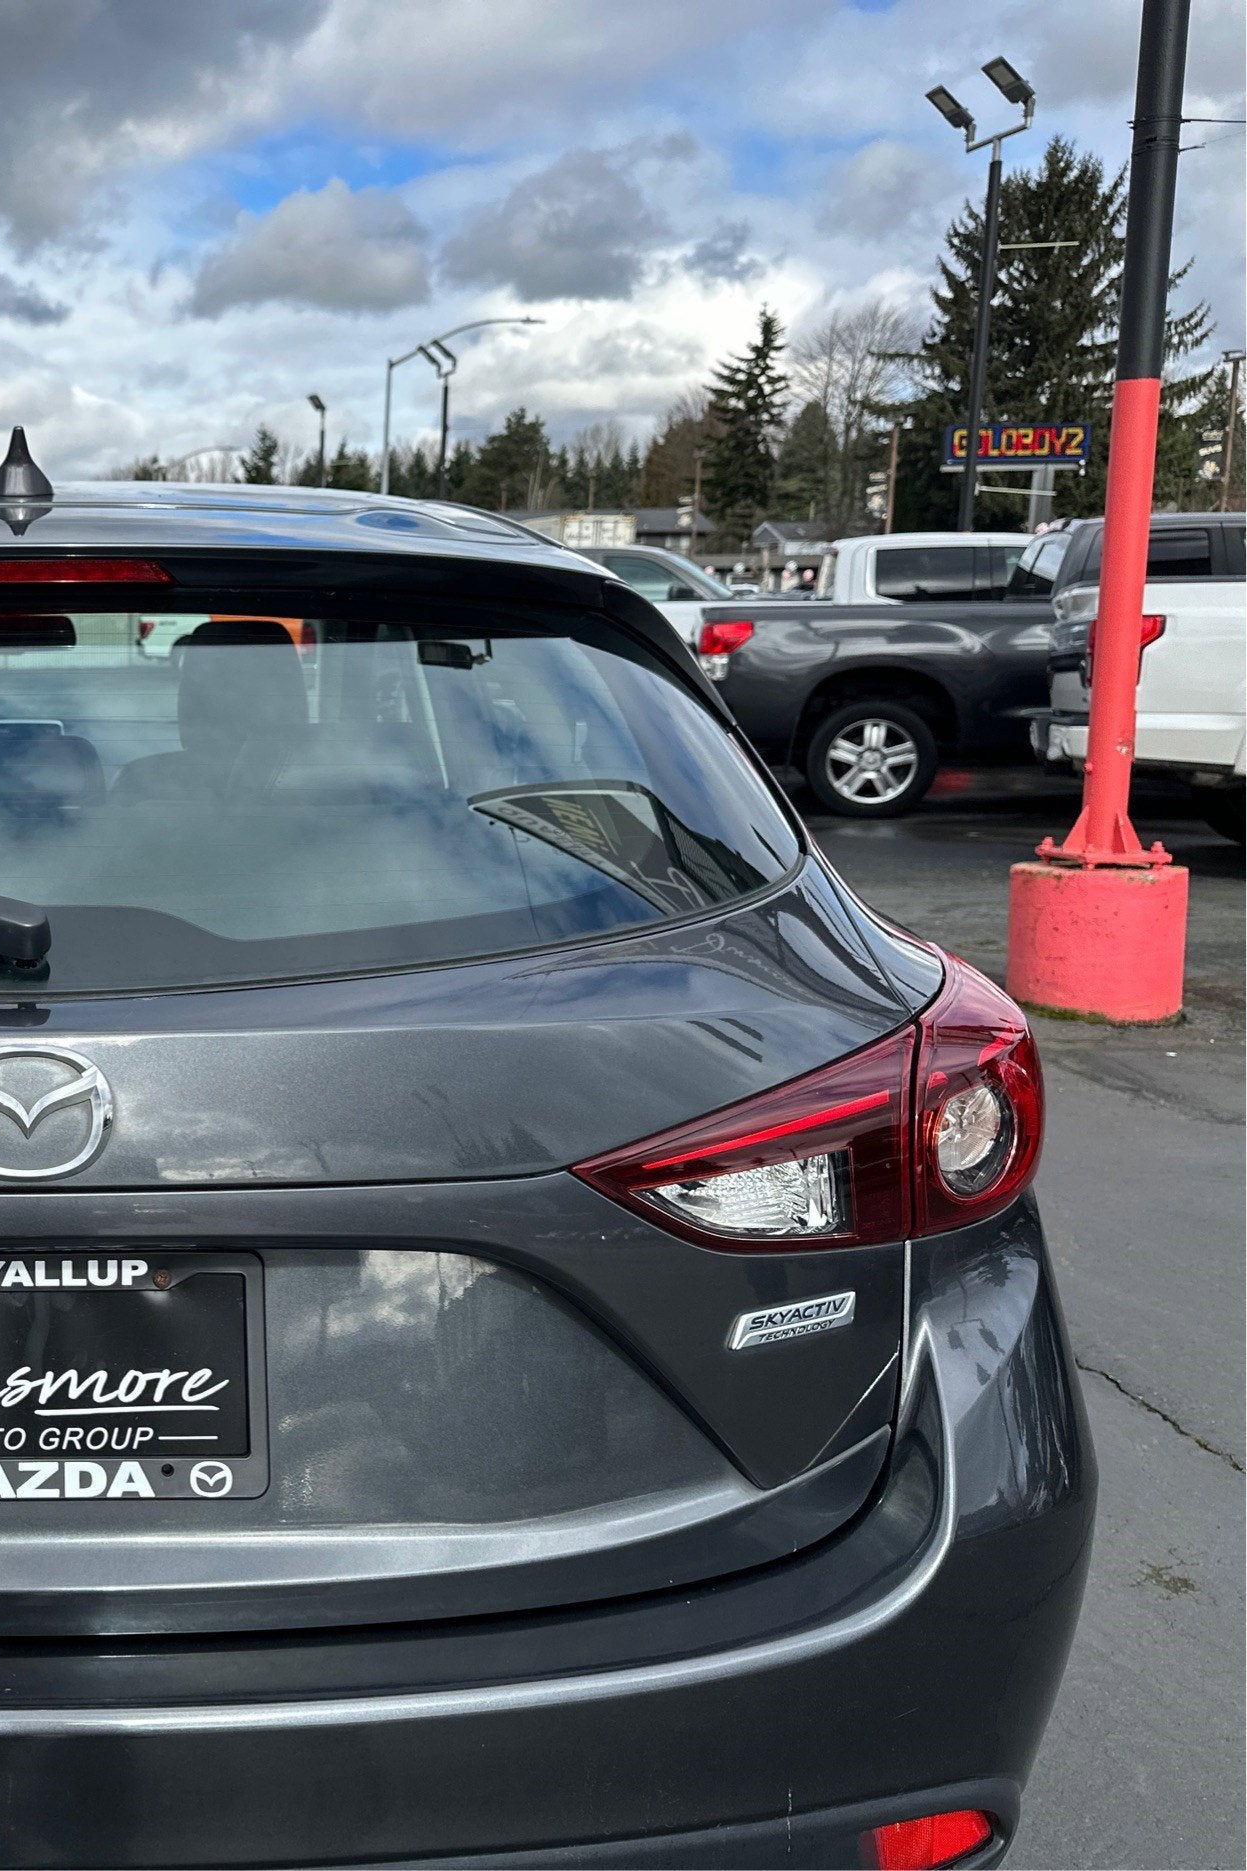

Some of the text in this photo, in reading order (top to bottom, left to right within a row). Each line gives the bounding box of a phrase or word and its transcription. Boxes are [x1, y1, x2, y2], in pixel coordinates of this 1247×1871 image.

[749, 1298, 845, 1330] SKYACTIV
[759, 1318, 835, 1342] TECHNOLOGY
[38, 1426, 154, 1451] GROUP
